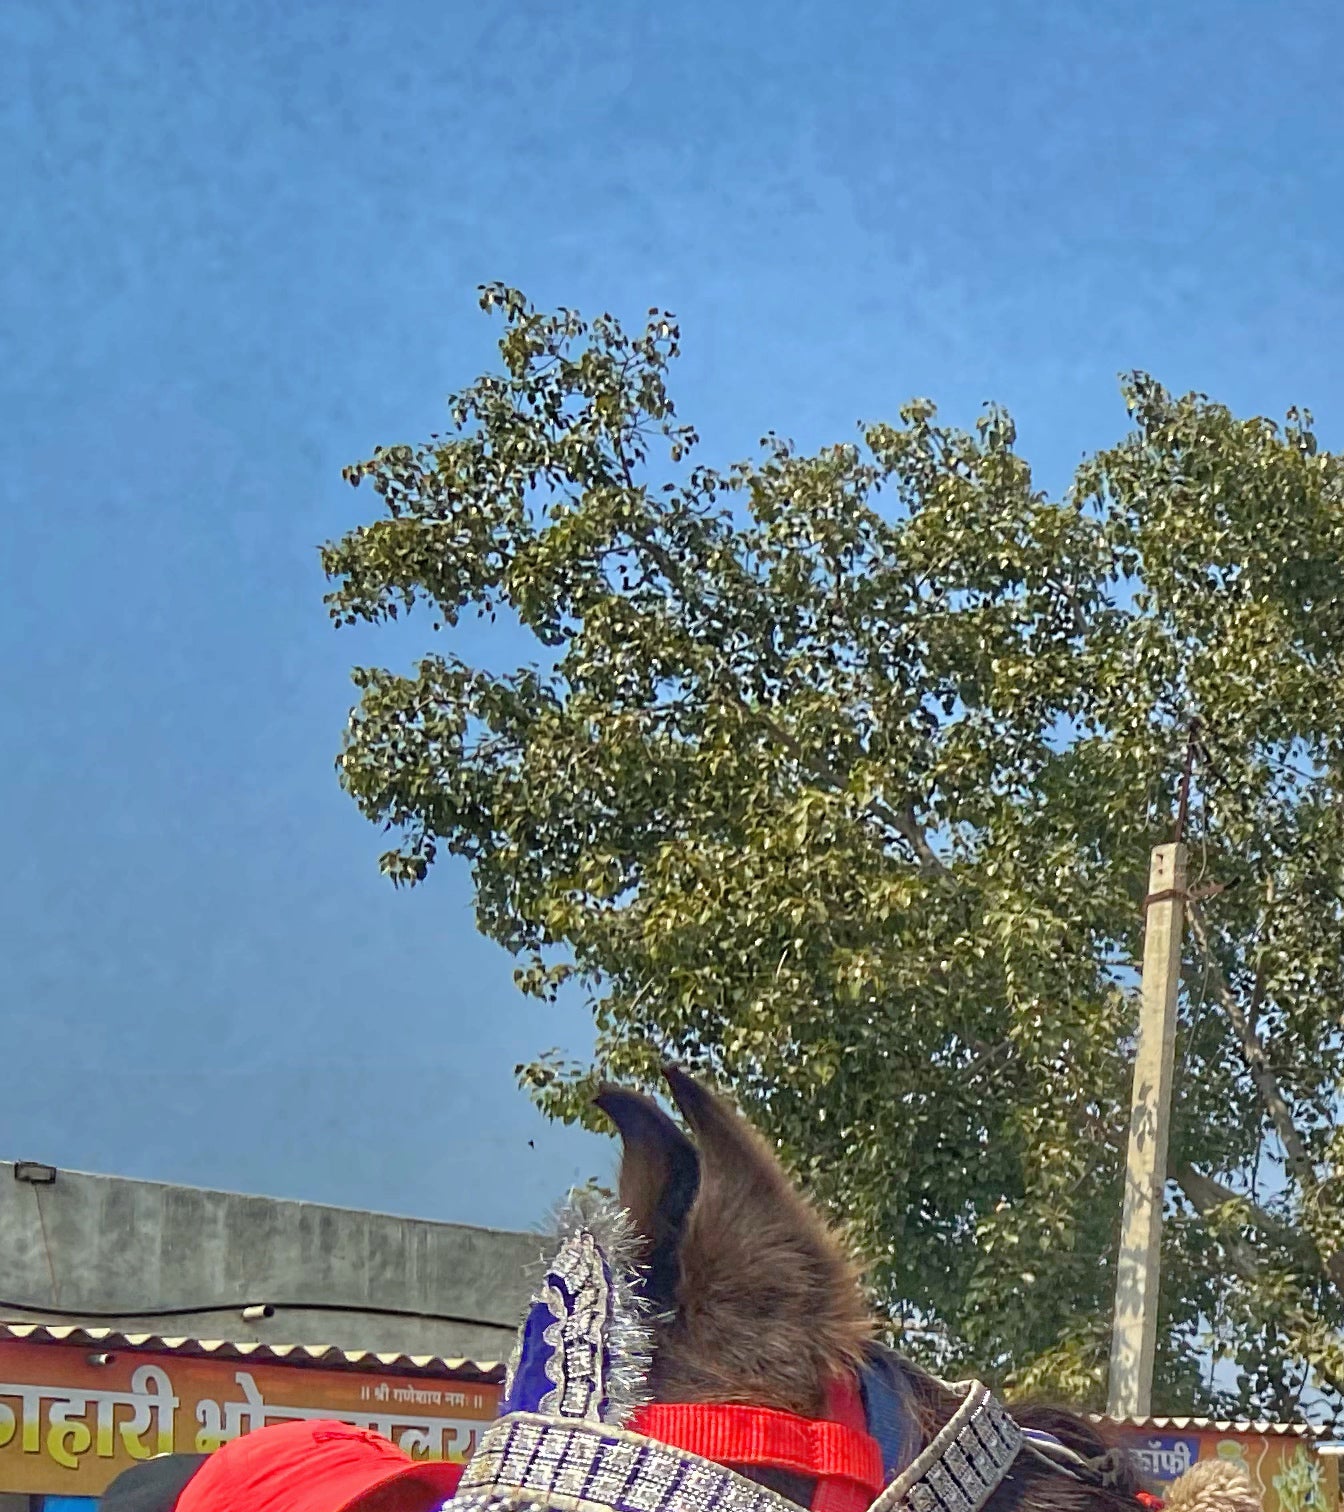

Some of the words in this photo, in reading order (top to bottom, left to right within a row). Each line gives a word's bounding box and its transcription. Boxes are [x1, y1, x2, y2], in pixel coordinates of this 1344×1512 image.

[0, 1364, 179, 1468] ाहारी
[374, 1383, 389, 1402] श्री
[393, 1384, 441, 1406] गणेशाय
